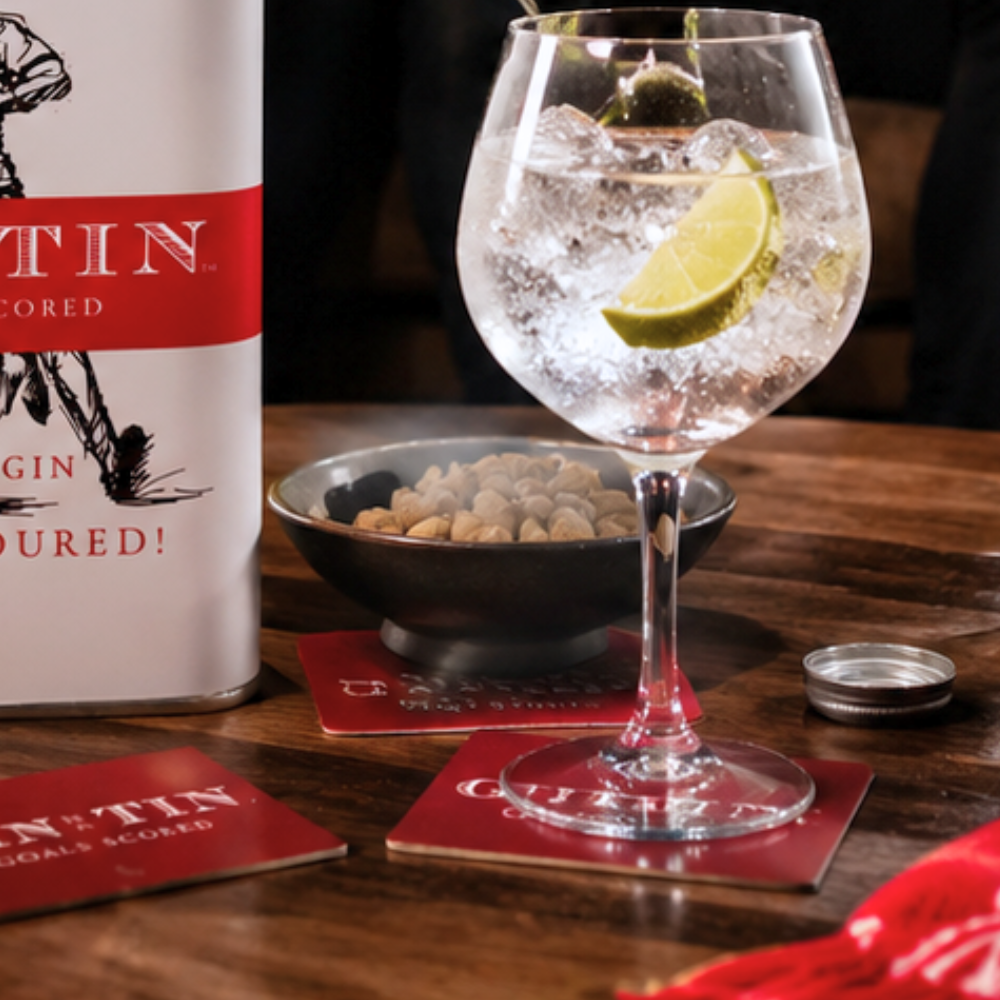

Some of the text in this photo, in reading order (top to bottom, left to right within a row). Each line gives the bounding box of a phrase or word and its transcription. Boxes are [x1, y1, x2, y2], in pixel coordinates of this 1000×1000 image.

[1, 454, 75, 480] GIN
[90, 785, 240, 828] TIN
[101, 818, 214, 847] SCORED
